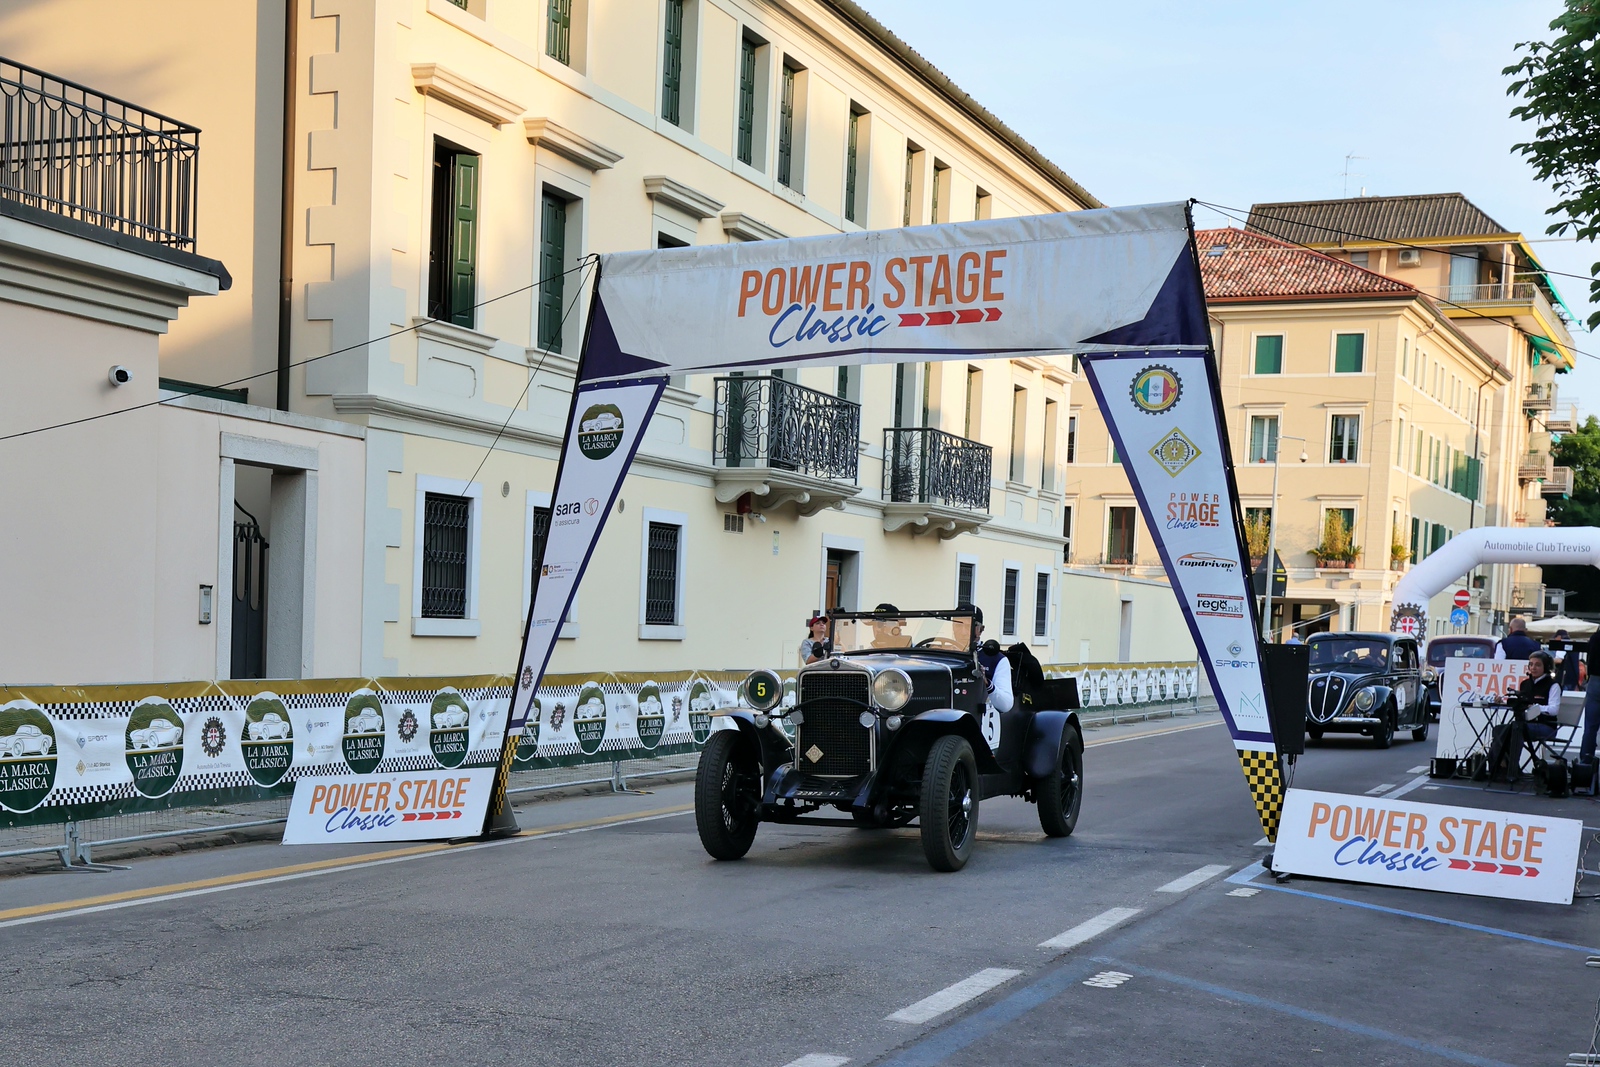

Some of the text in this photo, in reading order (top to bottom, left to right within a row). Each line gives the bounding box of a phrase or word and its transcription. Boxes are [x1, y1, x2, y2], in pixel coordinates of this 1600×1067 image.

[737, 249, 1007, 317] POWER STAGE
[769, 302, 891, 348] Classic
[582, 433, 618, 443] LA MARCA
[583, 441, 615, 450] CLASSICA
[1170, 492, 1219, 503] POWER
[556, 501, 581, 516] sara
[1166, 502, 1220, 522] STAGE
[1166, 517, 1199, 530] Classic
[1484, 540, 1591, 552] Automobile Club Treviso
[1179, 560, 1234, 569] topdriver
[1215, 659, 1256, 669] SPORT
[757, 682, 766, 697] 5
[577, 723, 587, 732] LA
[988, 711, 994, 741] 5
[346, 739, 356, 750] LA
[357, 737, 382, 748] MARCA
[433, 732, 465, 744] LA MARCA
[247, 745, 289, 757] LA MARCA
[347, 748, 380, 760] CLASSICA
[434, 742, 465, 753] CLASSICA
[133, 752, 177, 768] LA MARCA
[249, 757, 287, 769] CLASSICA
[0, 762, 51, 777] A MARCA
[137, 765, 176, 779] CLASSICA
[309, 777, 471, 814] POWER STAGE
[325, 806, 398, 833] Classic
[1307, 802, 1547, 864] POWER STAGE
[1334, 835, 1443, 872] Classic
